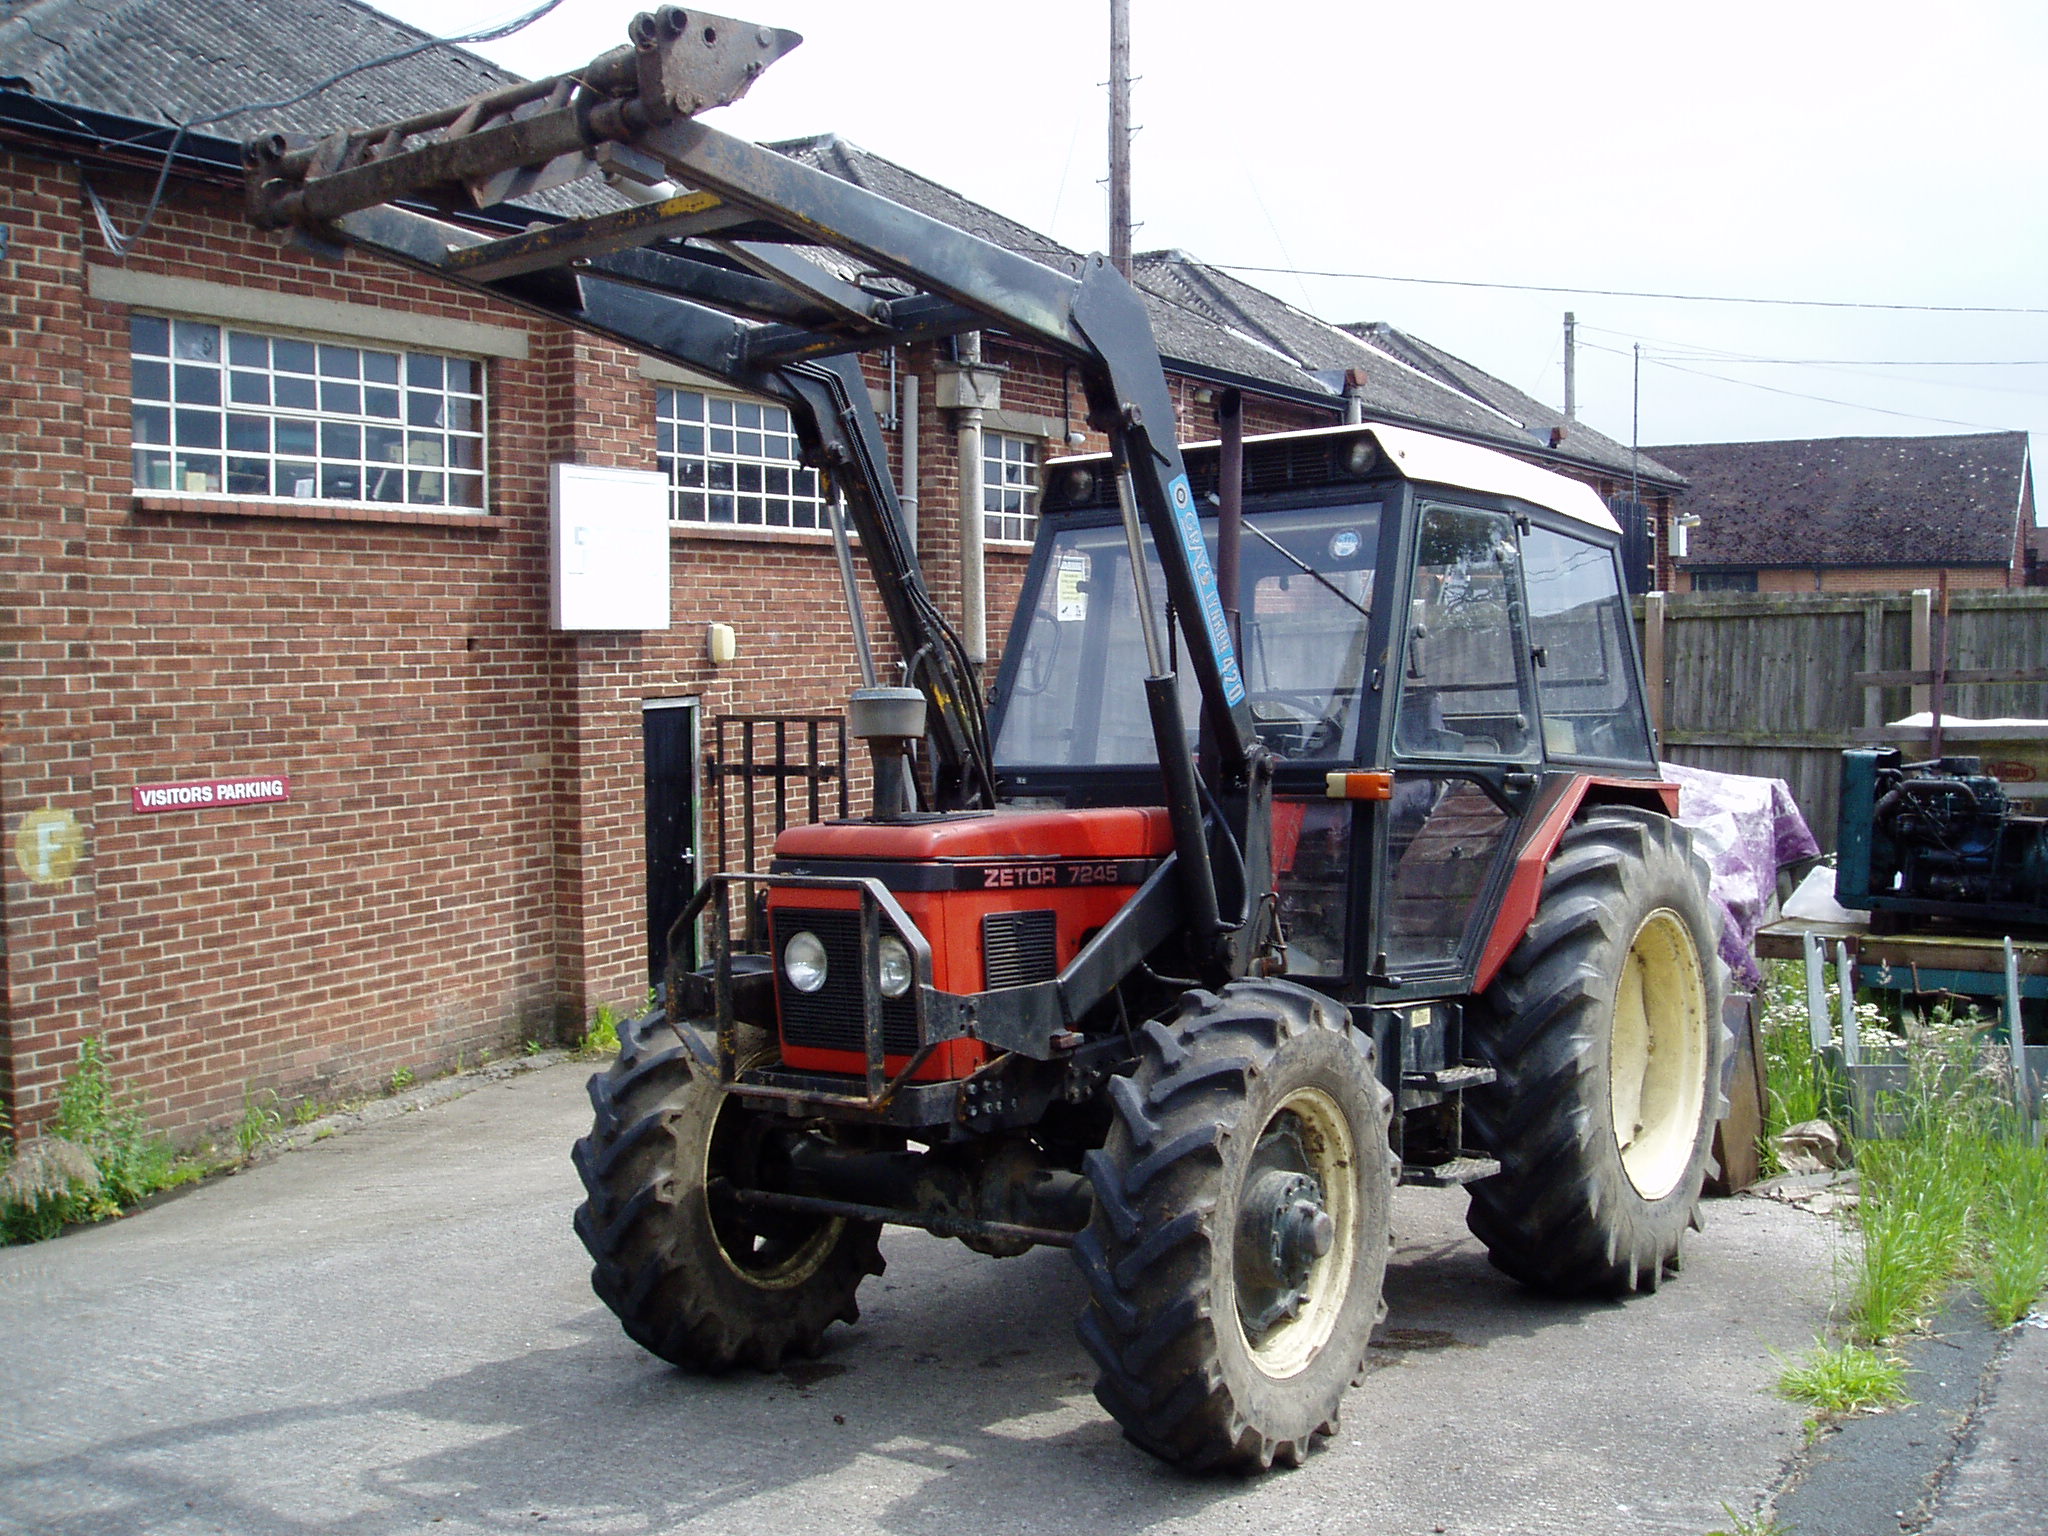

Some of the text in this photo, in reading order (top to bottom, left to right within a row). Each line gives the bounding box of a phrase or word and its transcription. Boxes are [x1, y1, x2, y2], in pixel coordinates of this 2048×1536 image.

[1222, 656, 1243, 702] 420
[140, 780, 283, 806] VISITORS PARKING
[37, 821, 66, 878] F
[984, 865, 1117, 887] ZETOR 7245
